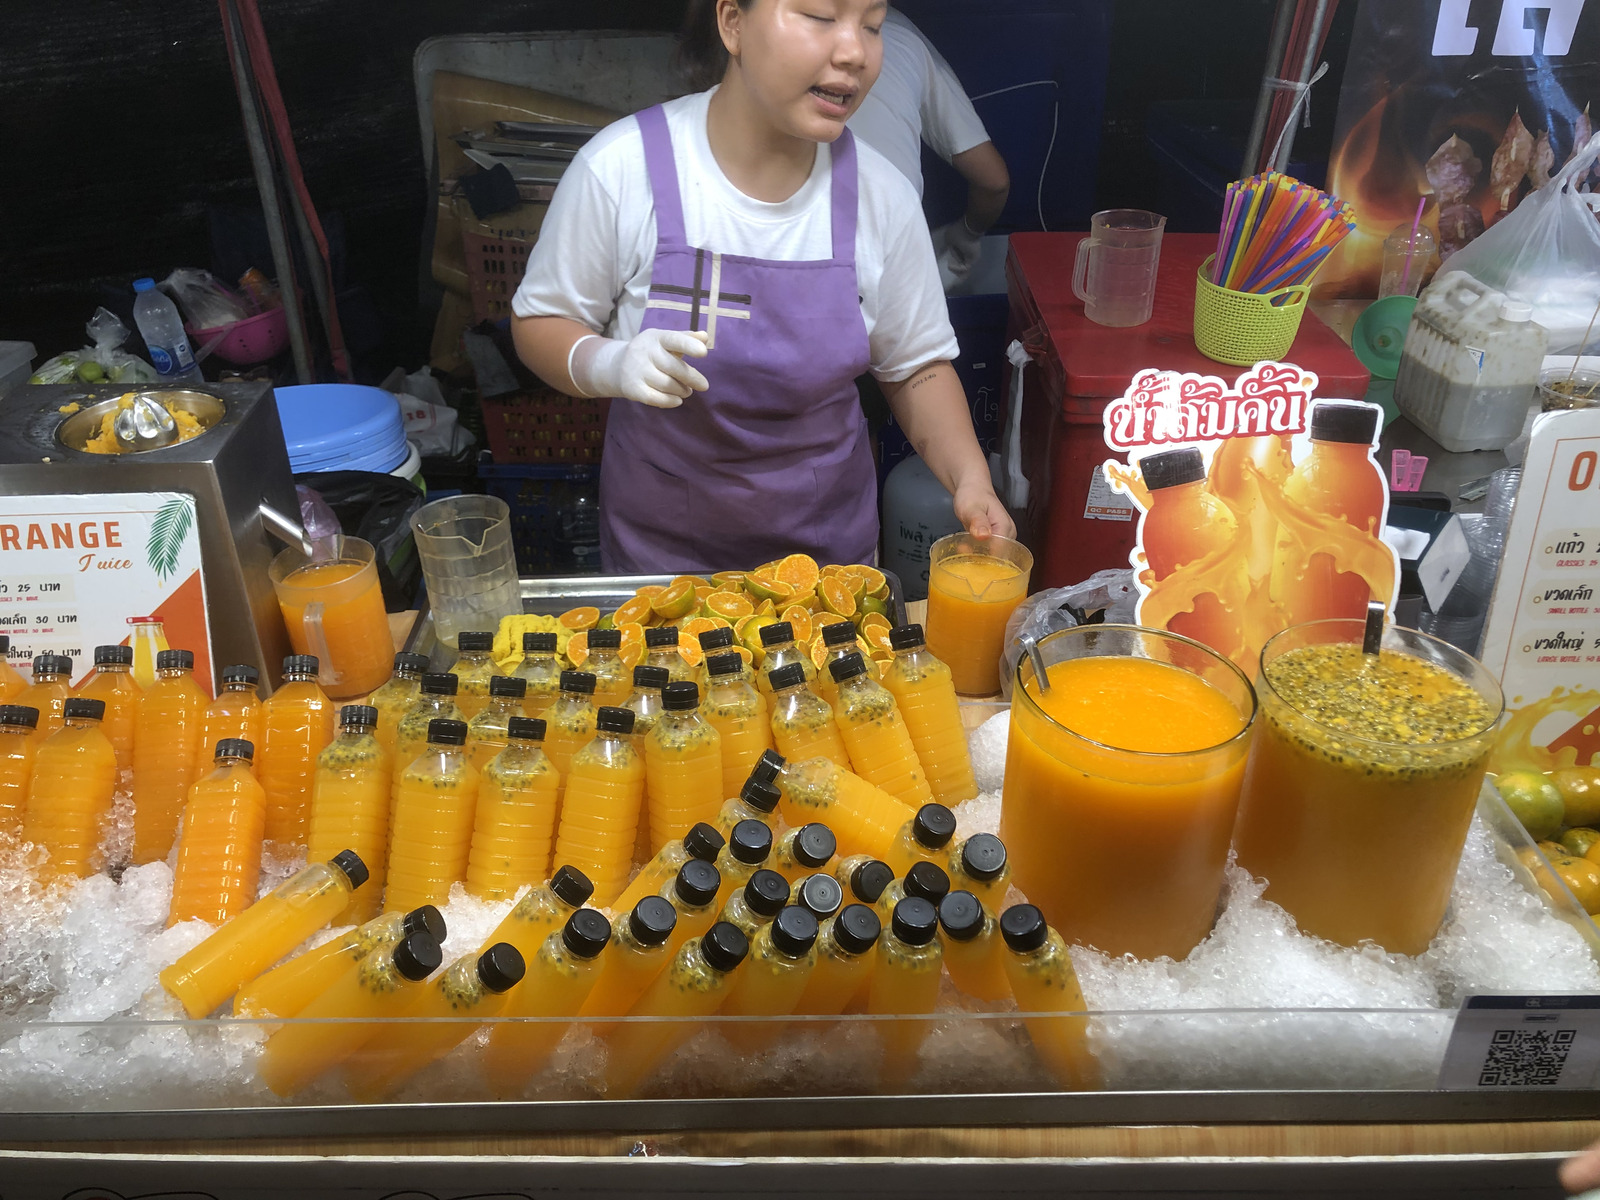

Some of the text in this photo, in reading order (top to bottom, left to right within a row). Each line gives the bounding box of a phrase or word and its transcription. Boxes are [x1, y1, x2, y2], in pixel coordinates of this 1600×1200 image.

[1110, 365, 1307, 447] น้ำส้มคั้น
[1555, 532, 1585, 554] แก้ว
[78, 553, 133, 572] Juice
[18, 583, 31, 593] 25
[40, 582, 61, 592] บาท
[1544, 584, 1593, 601] ขวดเล็ก
[36, 616, 49, 624] 30
[57, 615, 77, 623] บาท
[1534, 631, 1585, 651] ขวดใหญ่
[62, 648, 82, 657] บาท
